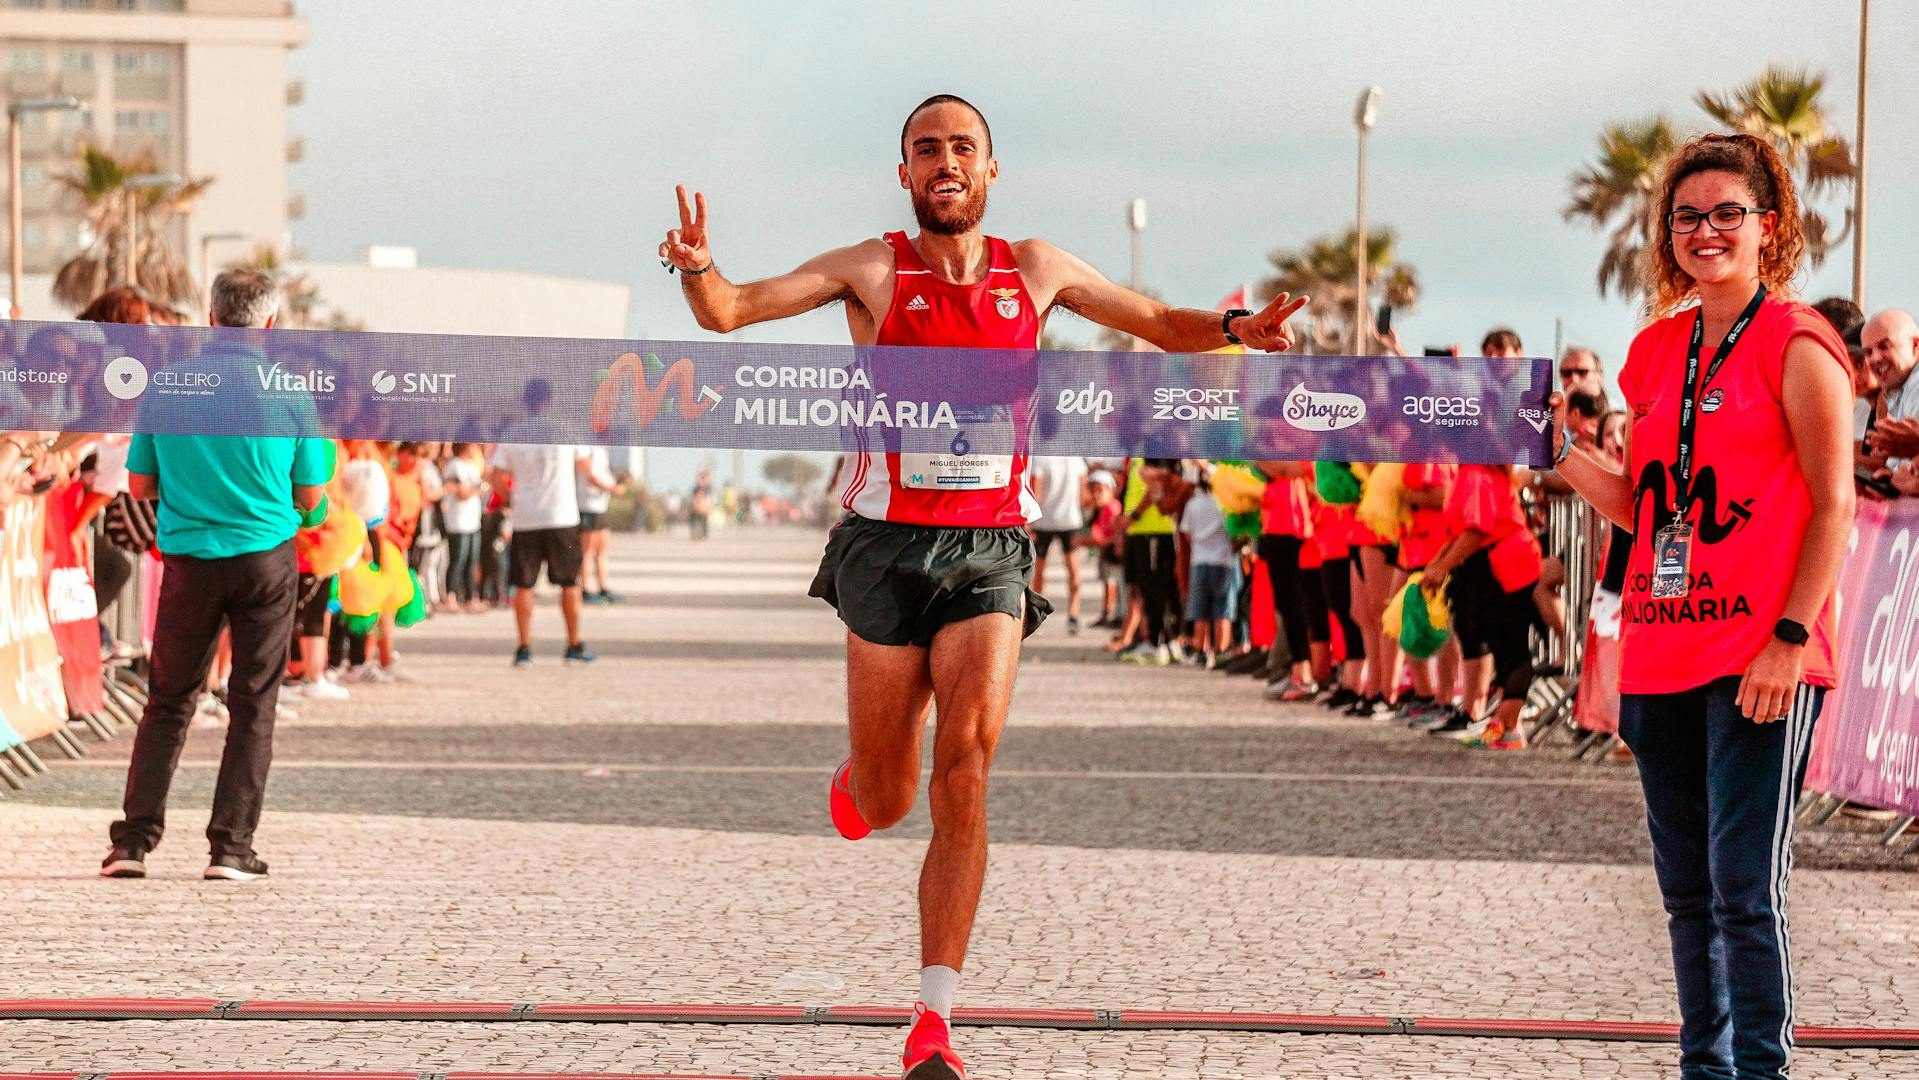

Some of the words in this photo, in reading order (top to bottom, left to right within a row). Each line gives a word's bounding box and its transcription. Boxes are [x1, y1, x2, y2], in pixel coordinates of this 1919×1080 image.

[153, 371, 221, 387] CELEIRO
[256, 361, 336, 393] Vitalis
[402, 372, 456, 394] SNT
[735, 365, 871, 390] CORRIDA
[1056, 381, 1114, 423] edp
[1153, 388, 1240, 404] SPORT
[734, 392, 959, 430] MILIONÁRIA
[1153, 405, 1240, 421] ZONE
[1287, 393, 1360, 428] Shoyce
[1402, 395, 1481, 424] ageas
[1435, 417, 1479, 428] seguros
[950, 431, 971, 456] 6
[1861, 527, 1919, 762] age
